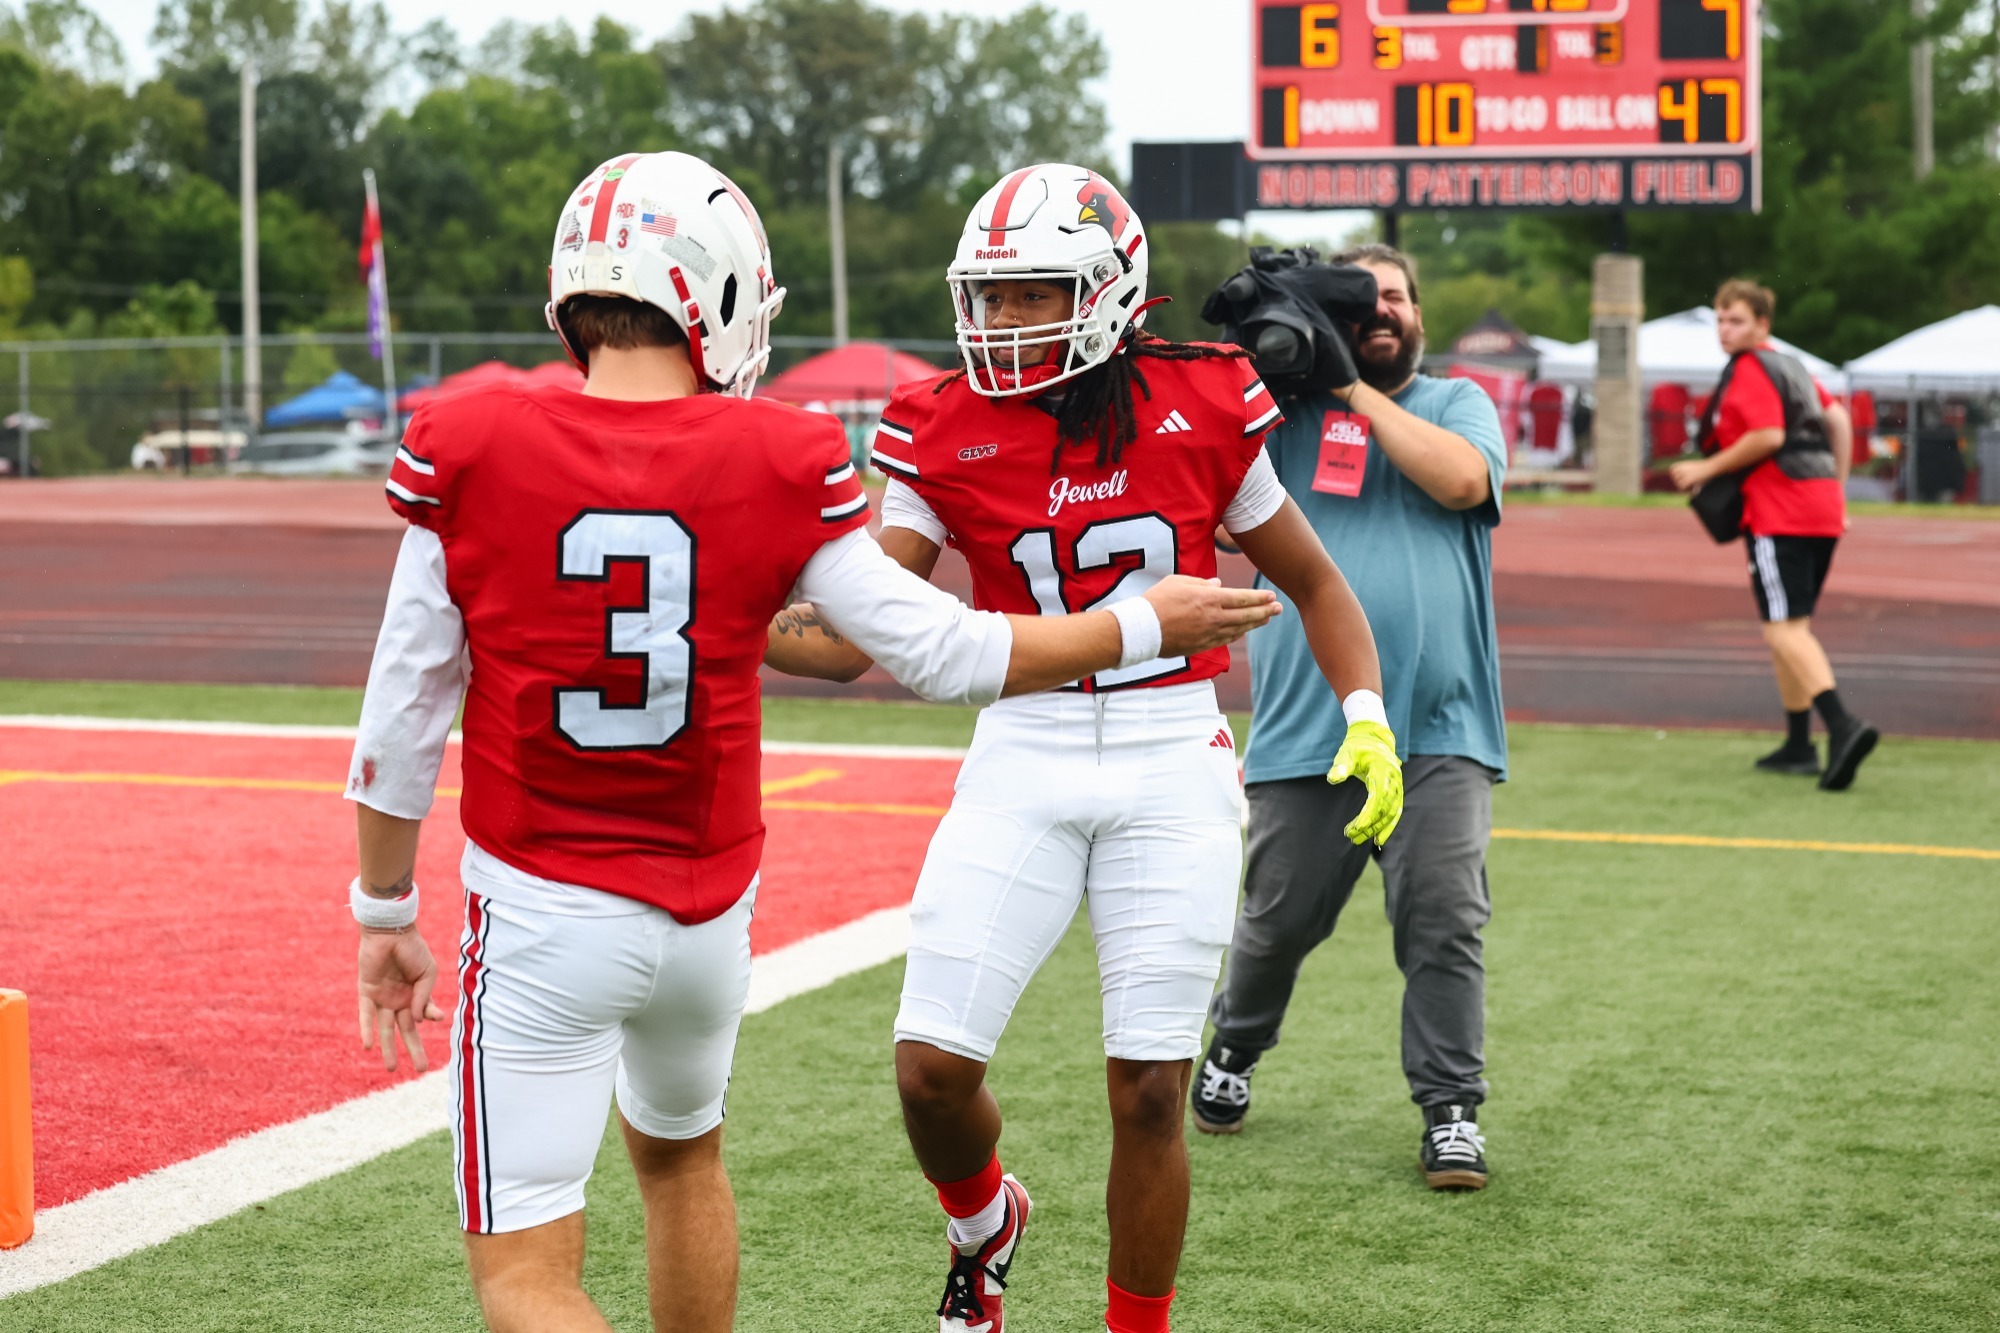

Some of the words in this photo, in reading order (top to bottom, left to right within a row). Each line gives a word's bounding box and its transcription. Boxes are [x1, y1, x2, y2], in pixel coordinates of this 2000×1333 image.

[1301, 4, 1339, 68] 6
[1373, 25, 1402, 69] 3
[1701, 0, 1740, 60] 7
[1284, 86, 1299, 148] 1
[1417, 82, 1475, 147] 10
[1658, 78, 1741, 144] 47
[1258, 163, 1399, 208] NORRIS
[1406, 160, 1624, 207] PATTERSON
[1632, 159, 1745, 205] FIELD
[617, 227, 629, 249] 3
[975, 248, 1018, 260] Riddell
[958, 444, 998, 461] GLVC
[1048, 469, 1129, 517] Jewell
[553, 508, 697, 752] 3
[1008, 511, 1190, 693] 12
